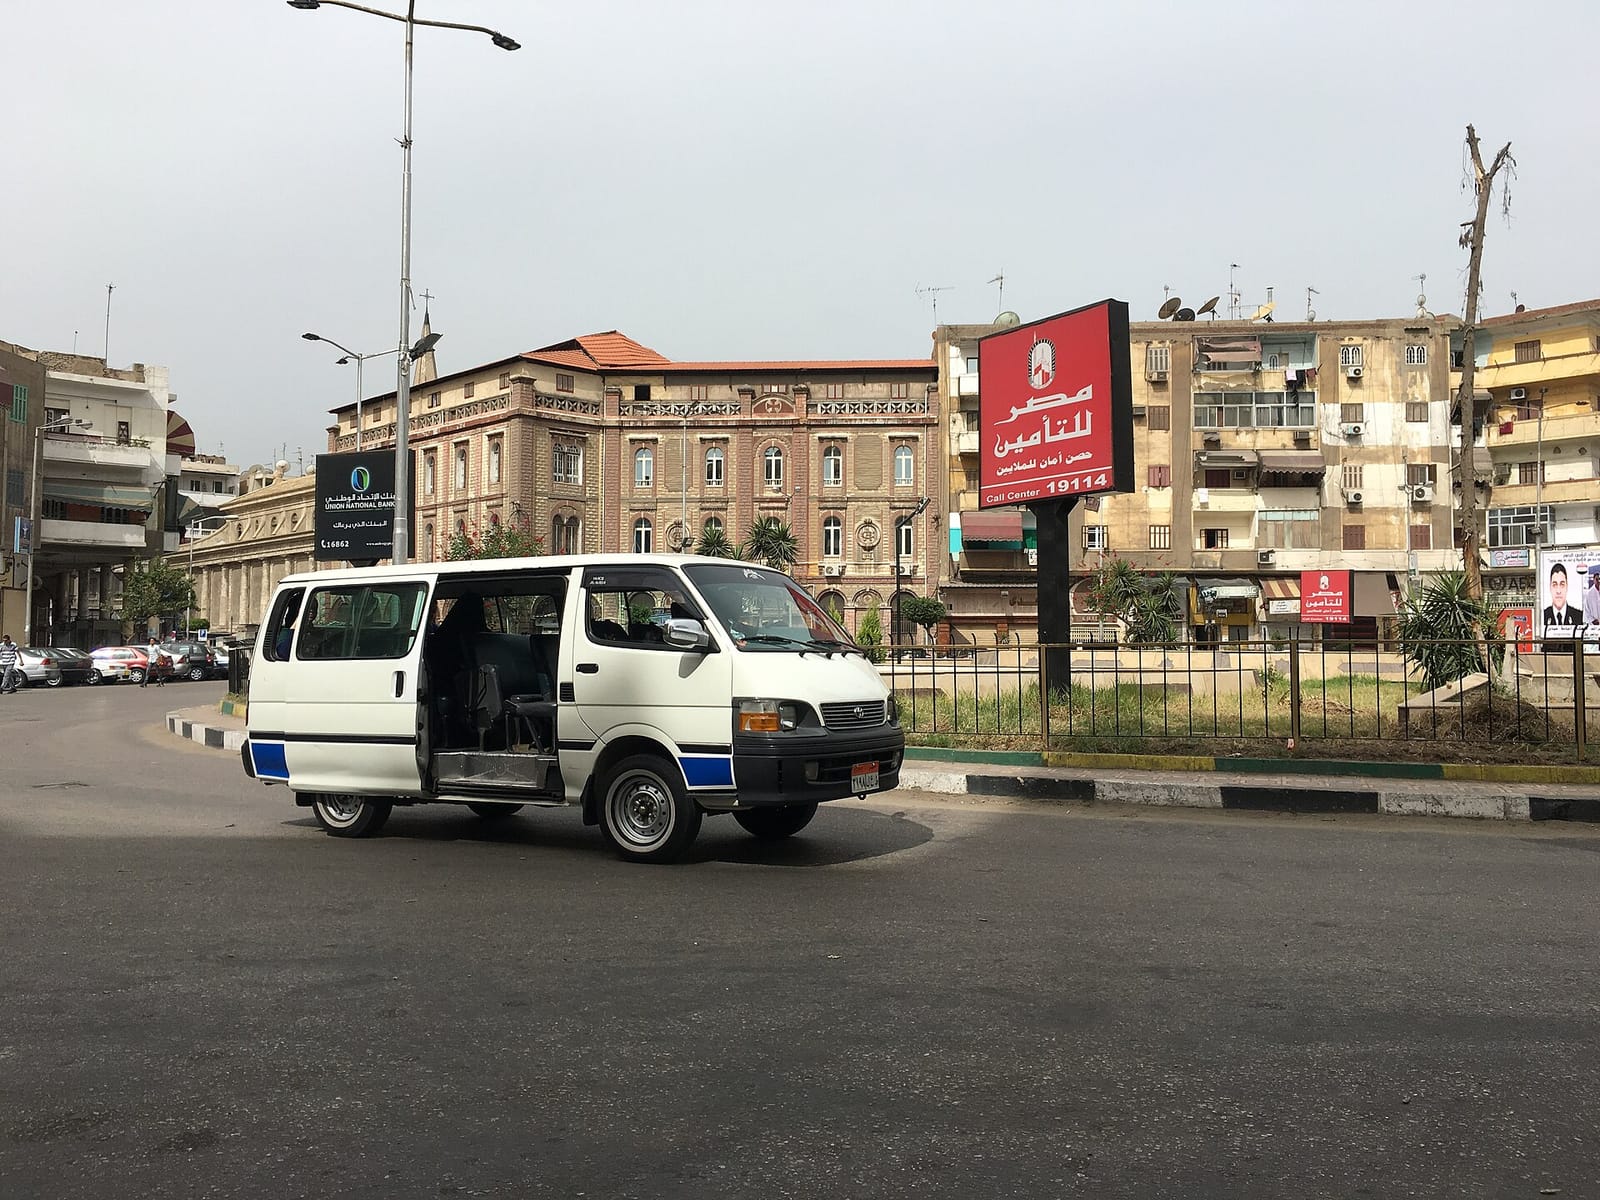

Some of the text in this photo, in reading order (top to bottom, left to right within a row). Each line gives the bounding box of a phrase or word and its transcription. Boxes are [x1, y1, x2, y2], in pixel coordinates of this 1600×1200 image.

[993, 383, 1093, 426] مصر
[994, 409, 1093, 458] للتأمين
[996, 450, 1093, 476] حصن أمان للملايين
[1046, 473, 1107, 494] 19114
[986, 489, 1040, 503] Call Center
[326, 540, 350, 548] 16862
[1305, 597, 1343, 608] للتأمين
